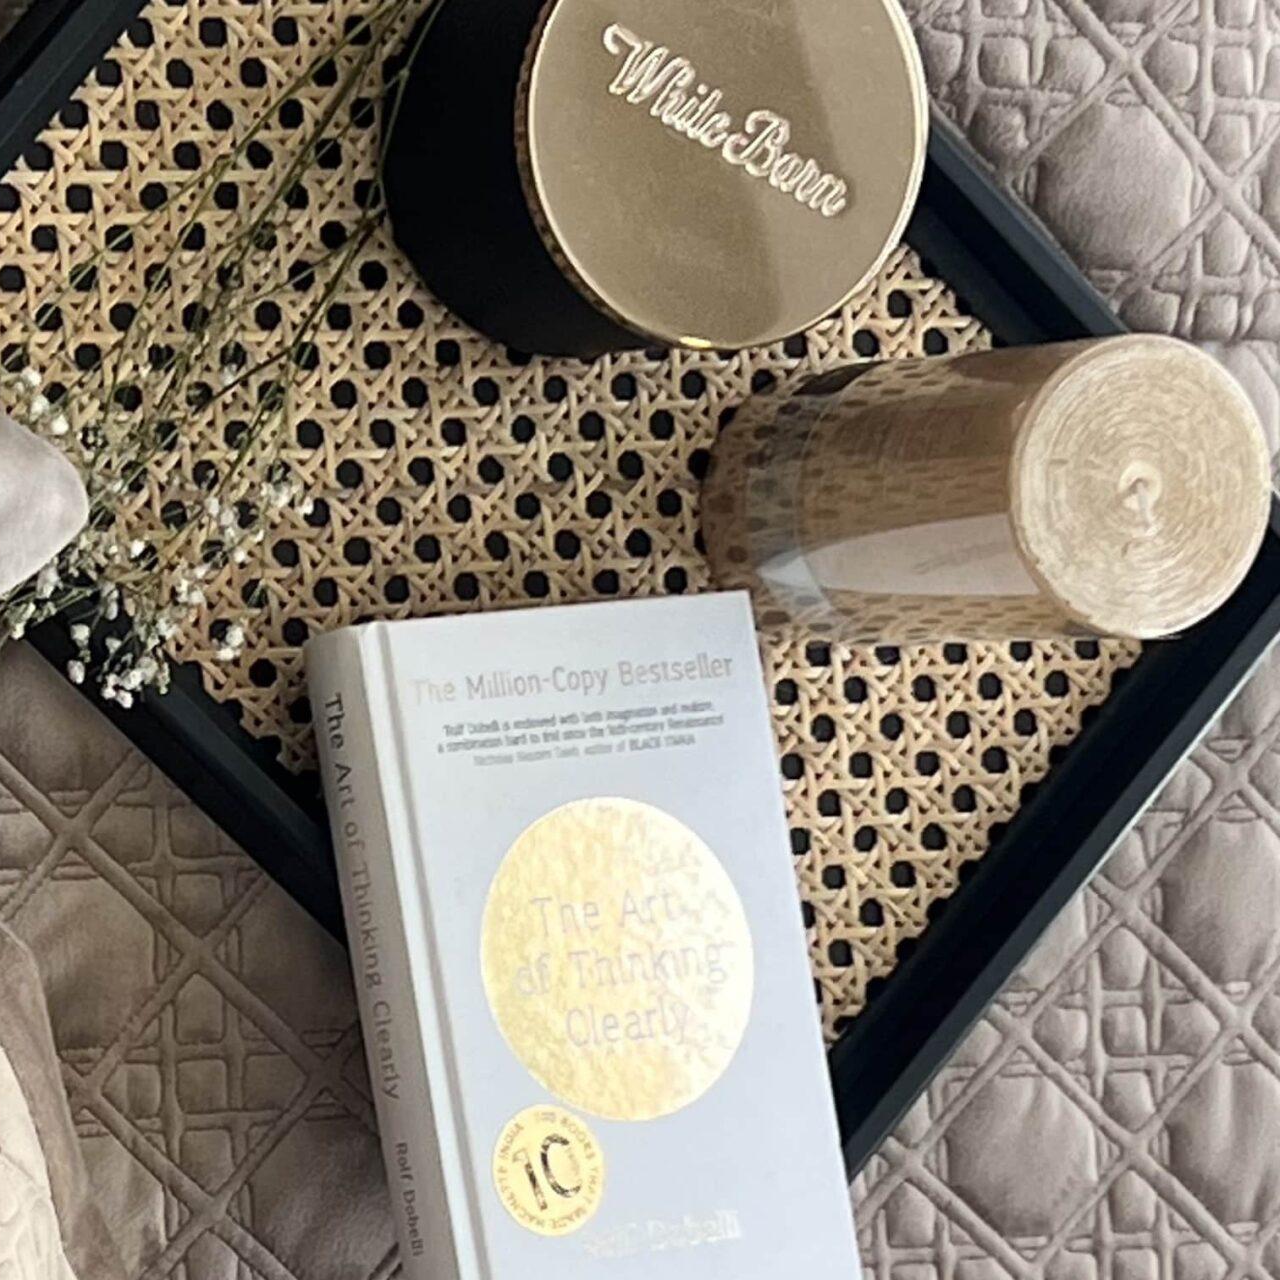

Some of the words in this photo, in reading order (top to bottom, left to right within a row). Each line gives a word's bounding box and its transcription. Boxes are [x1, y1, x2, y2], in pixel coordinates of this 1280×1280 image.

[603, 22, 731, 147] White
[722, 109, 848, 217] Barn
[413, 676, 455, 705] The
[466, 665, 608, 702] Million-Copy
[618, 653, 733, 687] Bestseller
[324, 692, 345, 749] The
[333, 761, 356, 808] Art
[343, 820, 366, 850] of
[350, 862, 384, 991] Thinking
[531, 893, 601, 938] The
[619, 886, 678, 930] Art
[513, 950, 552, 997] of
[568, 940, 730, 992] Thinking
[566, 996, 690, 1049] Clearly
[371, 1000, 400, 1101] Clearly
[396, 1141, 413, 1181] Rolf
[402, 1188, 424, 1257] Dobelli
